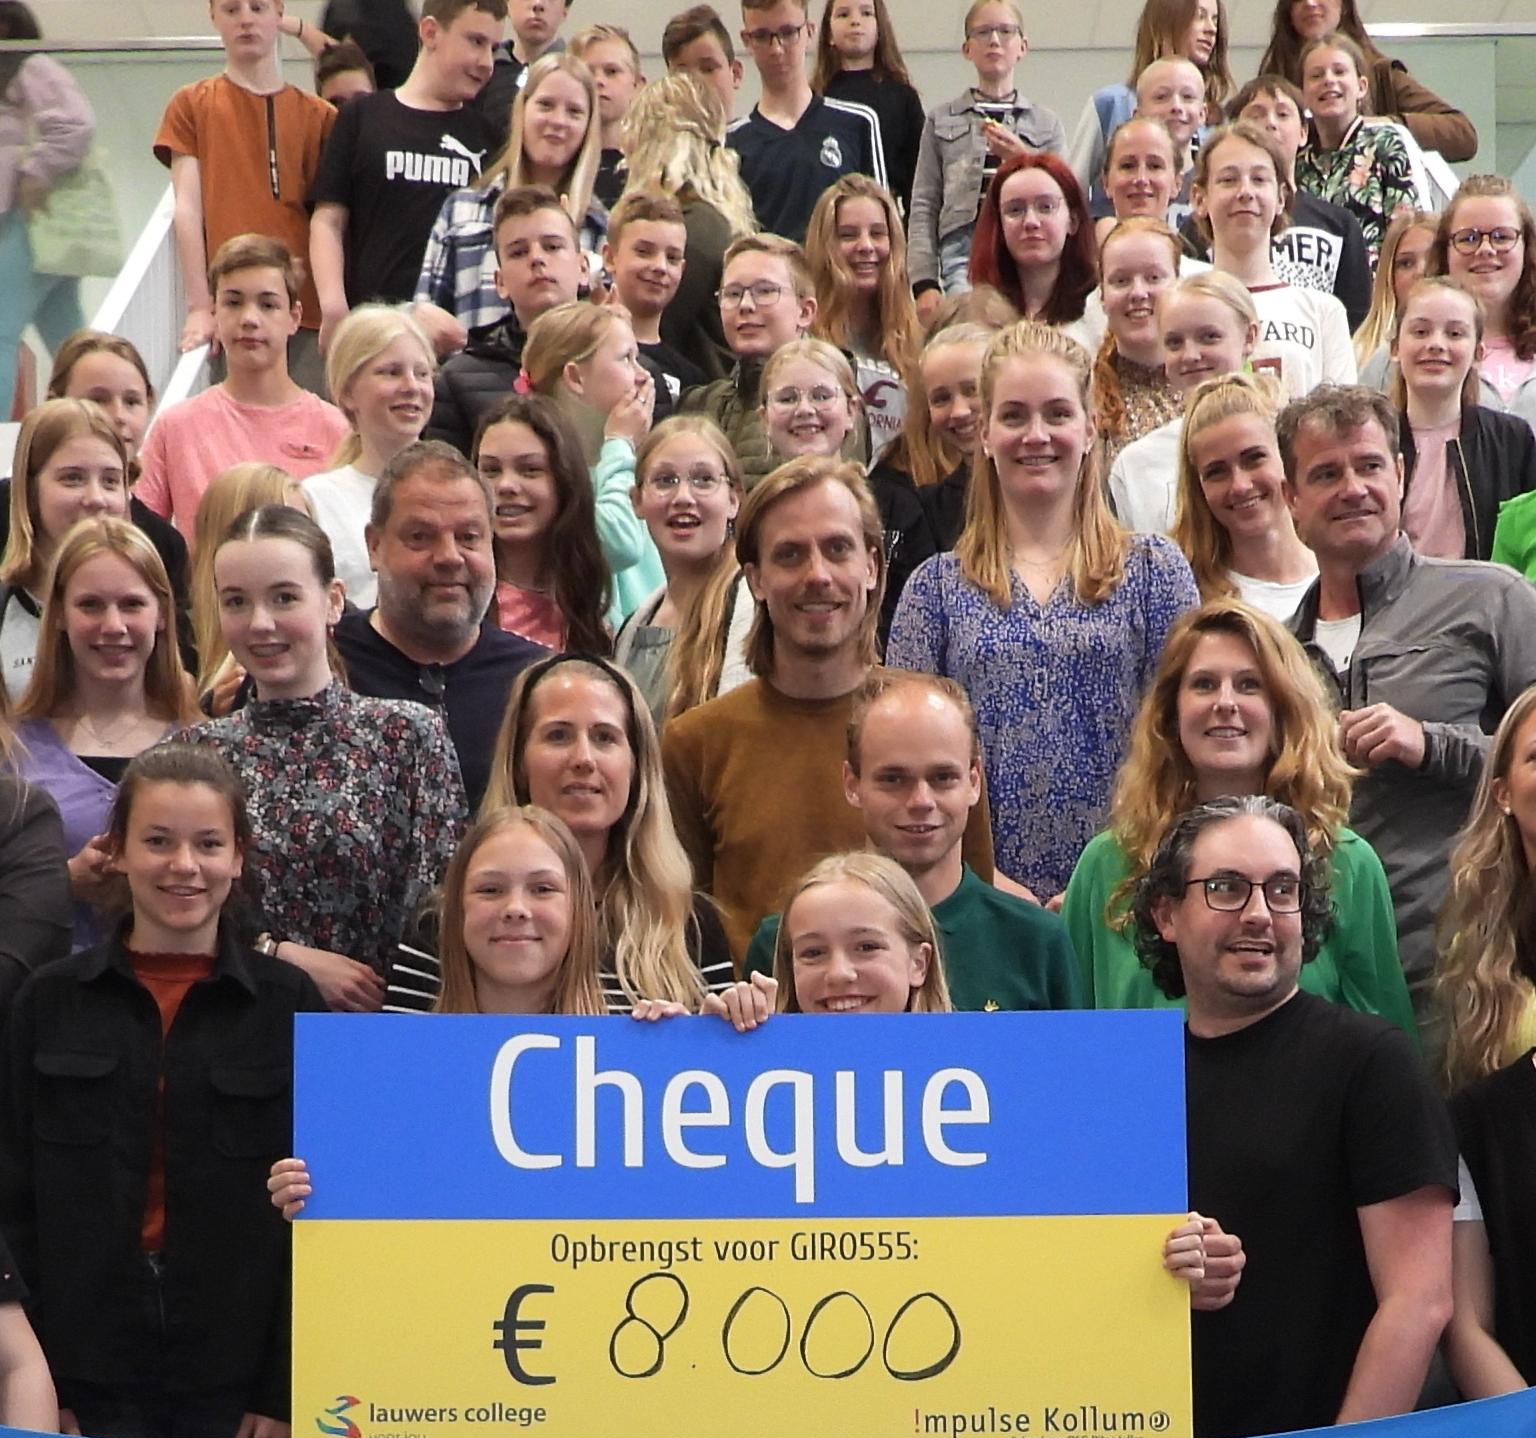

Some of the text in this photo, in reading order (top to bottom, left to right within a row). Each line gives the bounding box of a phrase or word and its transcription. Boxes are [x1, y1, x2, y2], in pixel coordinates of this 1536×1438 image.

[386, 151, 470, 187] PUMA
[1260, 320, 1315, 350] ARD
[489, 1033, 991, 1203] Cheque
[551, 1231, 919, 1270] Opbrengst voor GIRO555:
[492, 1283, 557, 1386] €
[370, 1403, 547, 1426] lauwers college
